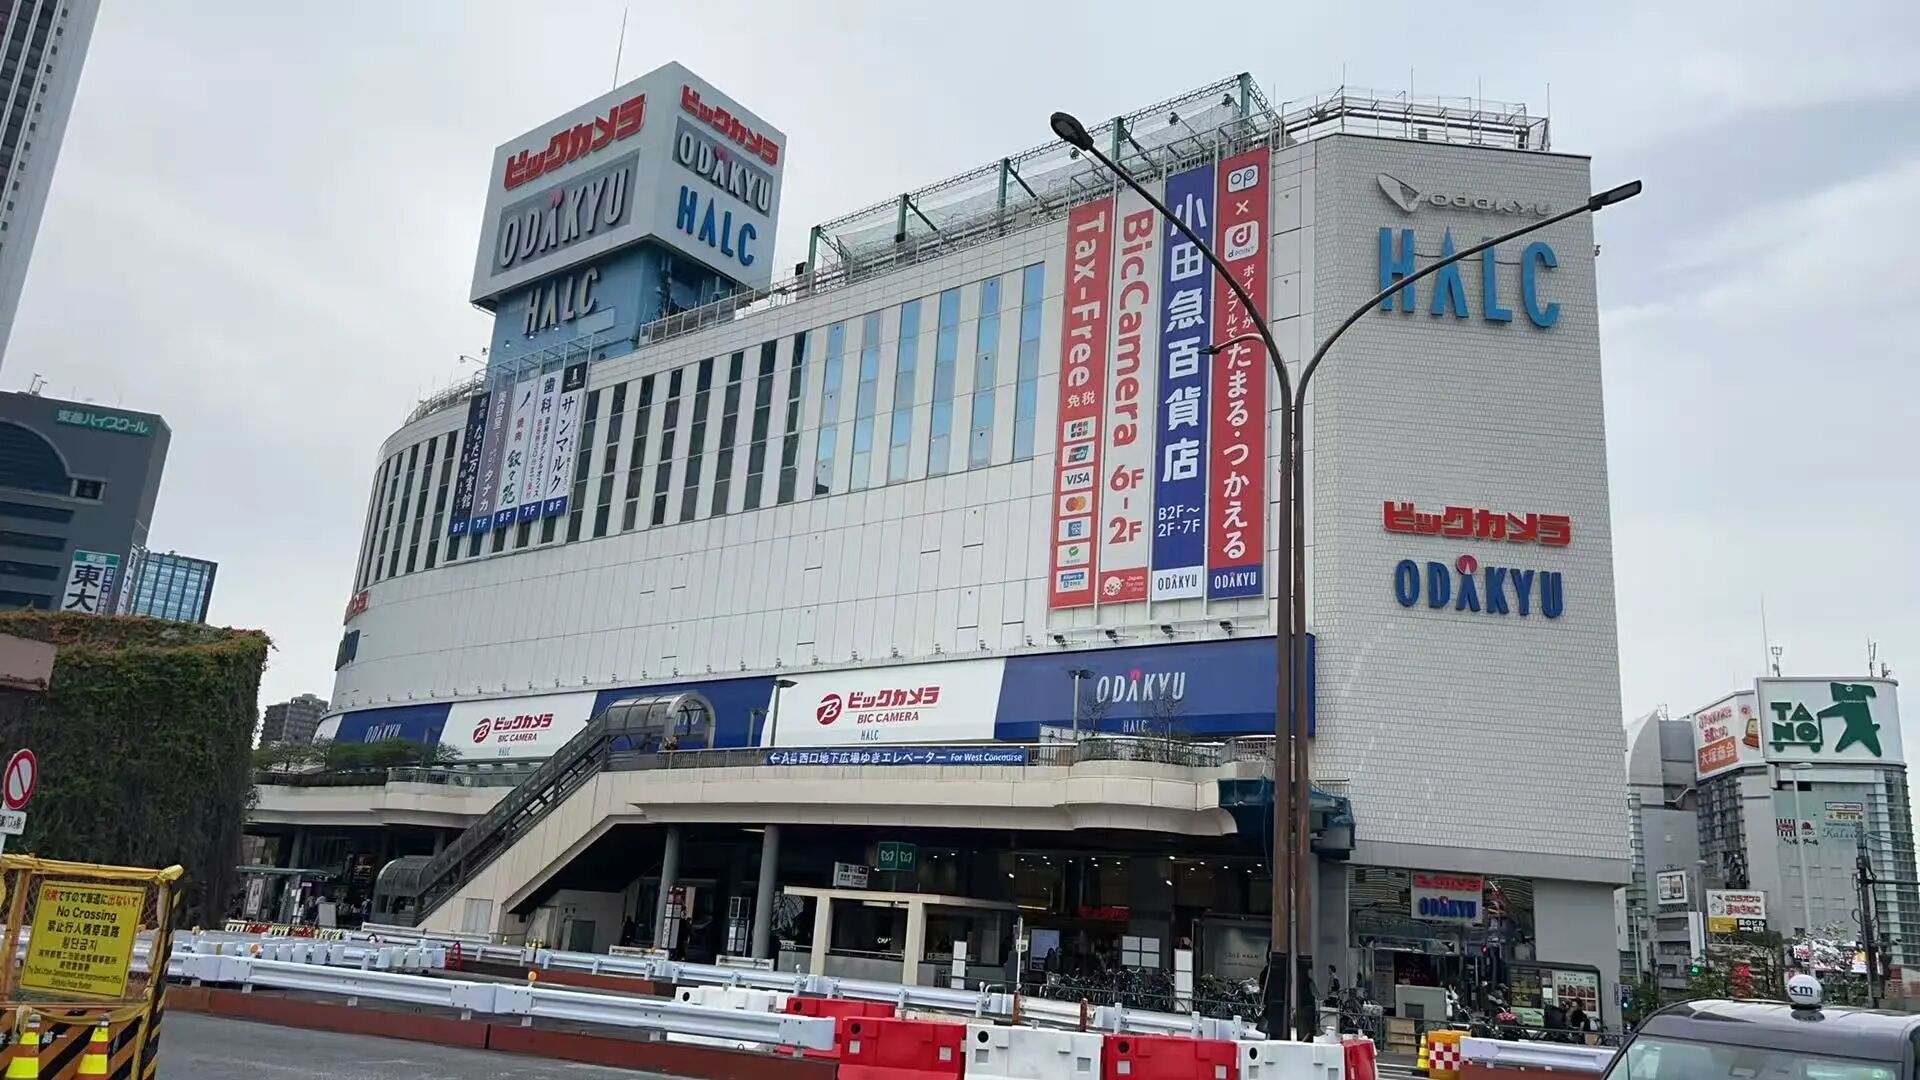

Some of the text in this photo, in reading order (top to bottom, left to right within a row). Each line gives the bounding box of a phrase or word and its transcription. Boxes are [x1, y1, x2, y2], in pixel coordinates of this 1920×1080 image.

[681, 83, 779, 166] ビックカメラ
[504, 93, 647, 191] ビックカメラ
[679, 131, 770, 211] ODAKYU
[500, 168, 628, 267] ODAKYU
[677, 185, 757, 266] HALC
[1378, 225, 1562, 328] HALC
[522, 267, 598, 338] HALC
[1068, 210, 1105, 387] Tax-Free
[1113, 209, 1155, 448] BicCamera
[1162, 193, 1207, 482] 小田急百貨店
[541, 377, 556, 414] 歯科
[1066, 391, 1095, 409] 免税
[57, 410, 148, 434] 東進ハイスクール
[551, 396, 575, 493] サンマルク
[1222, 341, 1252, 560] たまる・つかえる
[479, 470, 494, 513] タナカ
[500, 450, 522, 506] 叙々苑
[1066, 472, 1090, 485] VISA
[1110, 464, 1145, 492] 6F
[476, 518, 487, 529] 7F
[524, 505, 535, 517] 7F
[1383, 500, 1571, 546] ビックカメラ
[1109, 516, 1142, 545] 2F
[65, 563, 103, 612] 東大
[1158, 574, 1197, 591] ODAKYU
[1214, 572, 1257, 589] ODAKYU
[1395, 553, 1565, 619] ODAKYU
[848, 686, 940, 709] ビックカメラ
[1096, 668, 1186, 703] ODAKYU
[493, 713, 553, 731] ビックカメラ
[857, 711, 919, 724] BIC CAMERA
[1123, 720, 1148, 733] HALC
[365, 722, 401, 744] ODAKYU
[497, 733, 537, 743] BIC CAMERA
[860, 729, 879, 741] HALC
[950, 753, 1023, 762] For West Concourse
[56, 906, 117, 923] No Crossing
[1419, 896, 1477, 919] ODAKYU
[1790, 985, 1813, 995] km
